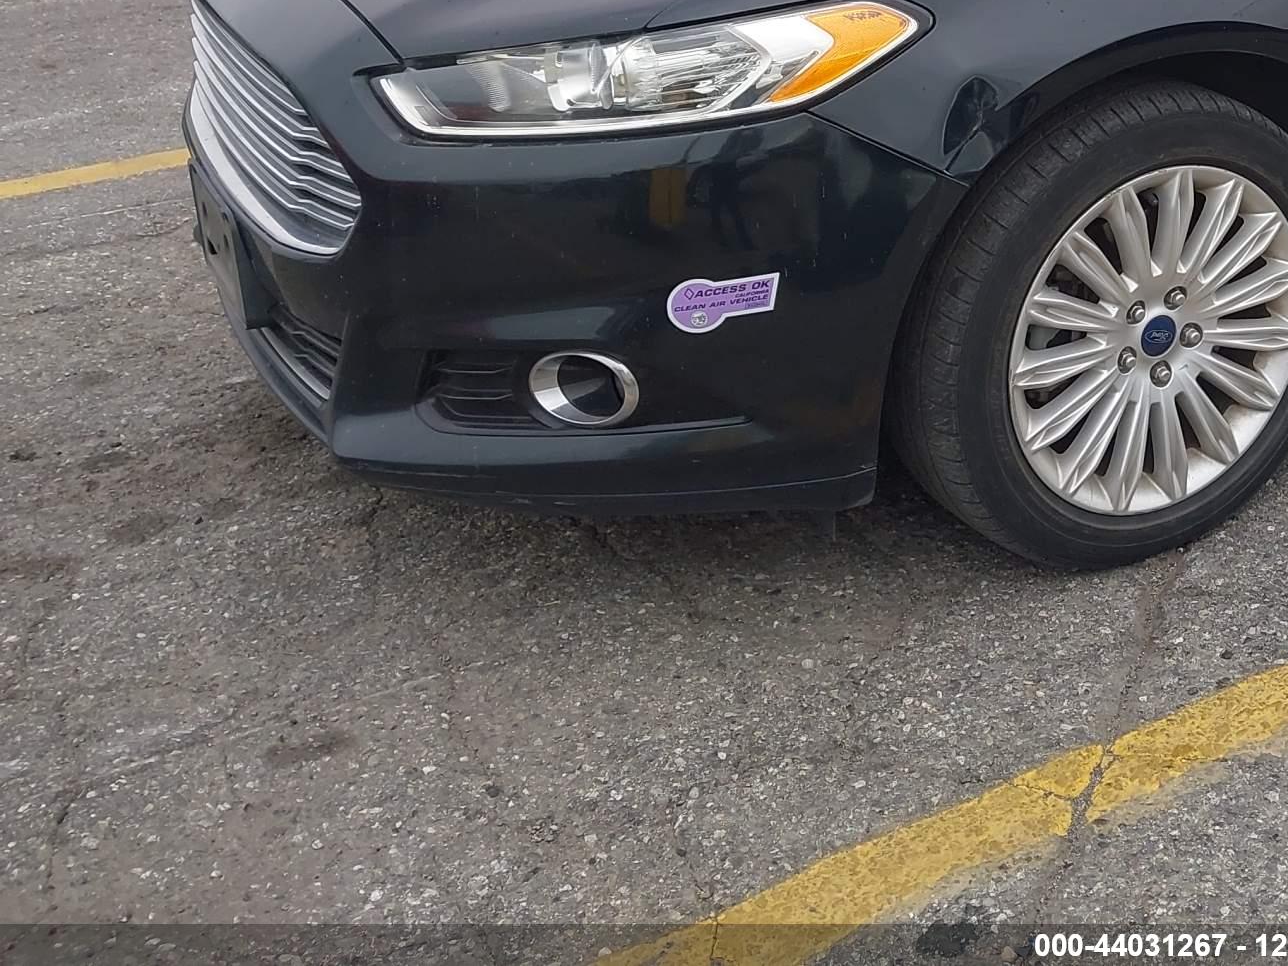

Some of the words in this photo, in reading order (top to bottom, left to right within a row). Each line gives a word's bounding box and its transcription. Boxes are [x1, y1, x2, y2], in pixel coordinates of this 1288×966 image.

[694, 284, 747, 299] ACCESS
[751, 279, 771, 290] OK
[674, 301, 706, 313] CLEAN
[708, 300, 726, 308] AIR
[730, 294, 769, 305] VEHICLE
